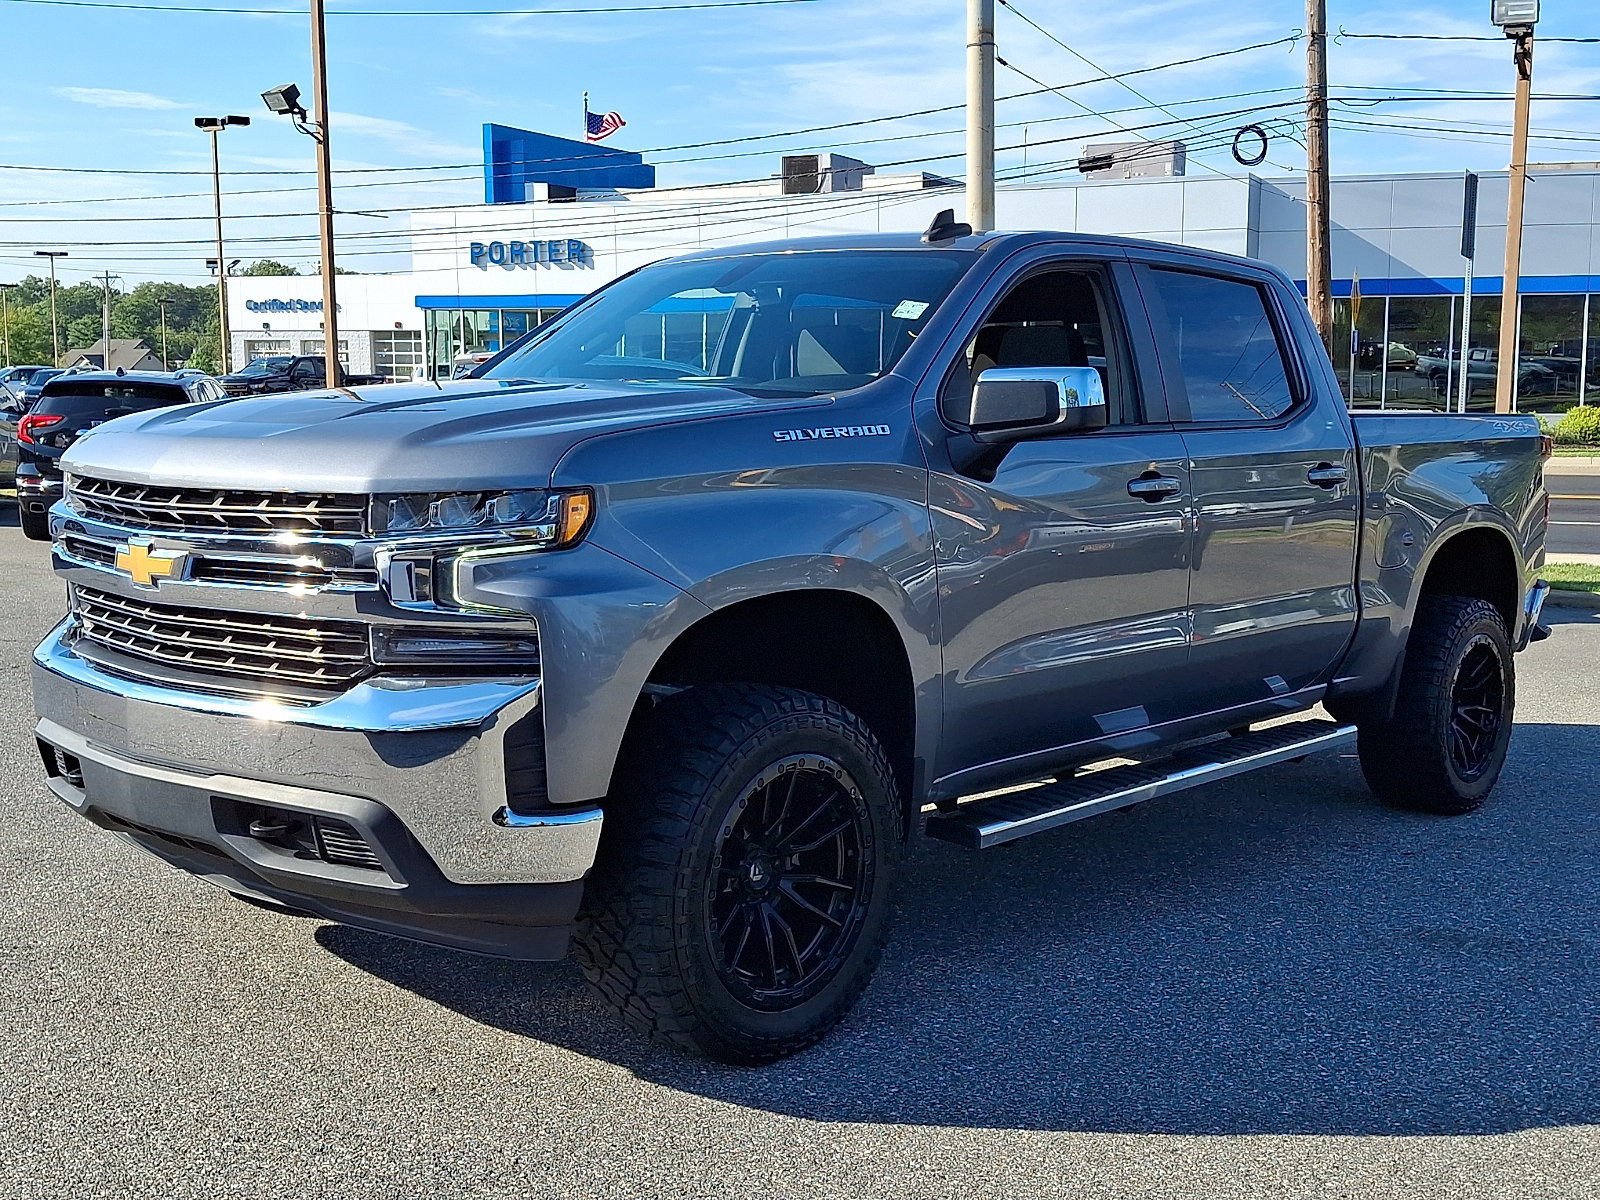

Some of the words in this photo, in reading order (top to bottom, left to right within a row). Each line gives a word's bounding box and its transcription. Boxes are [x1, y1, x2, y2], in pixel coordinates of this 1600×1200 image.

[470, 239, 586, 266] PORTER
[246, 298, 295, 312] Certified
[296, 298, 341, 312] Servi
[773, 424, 891, 442] SILVERADO
